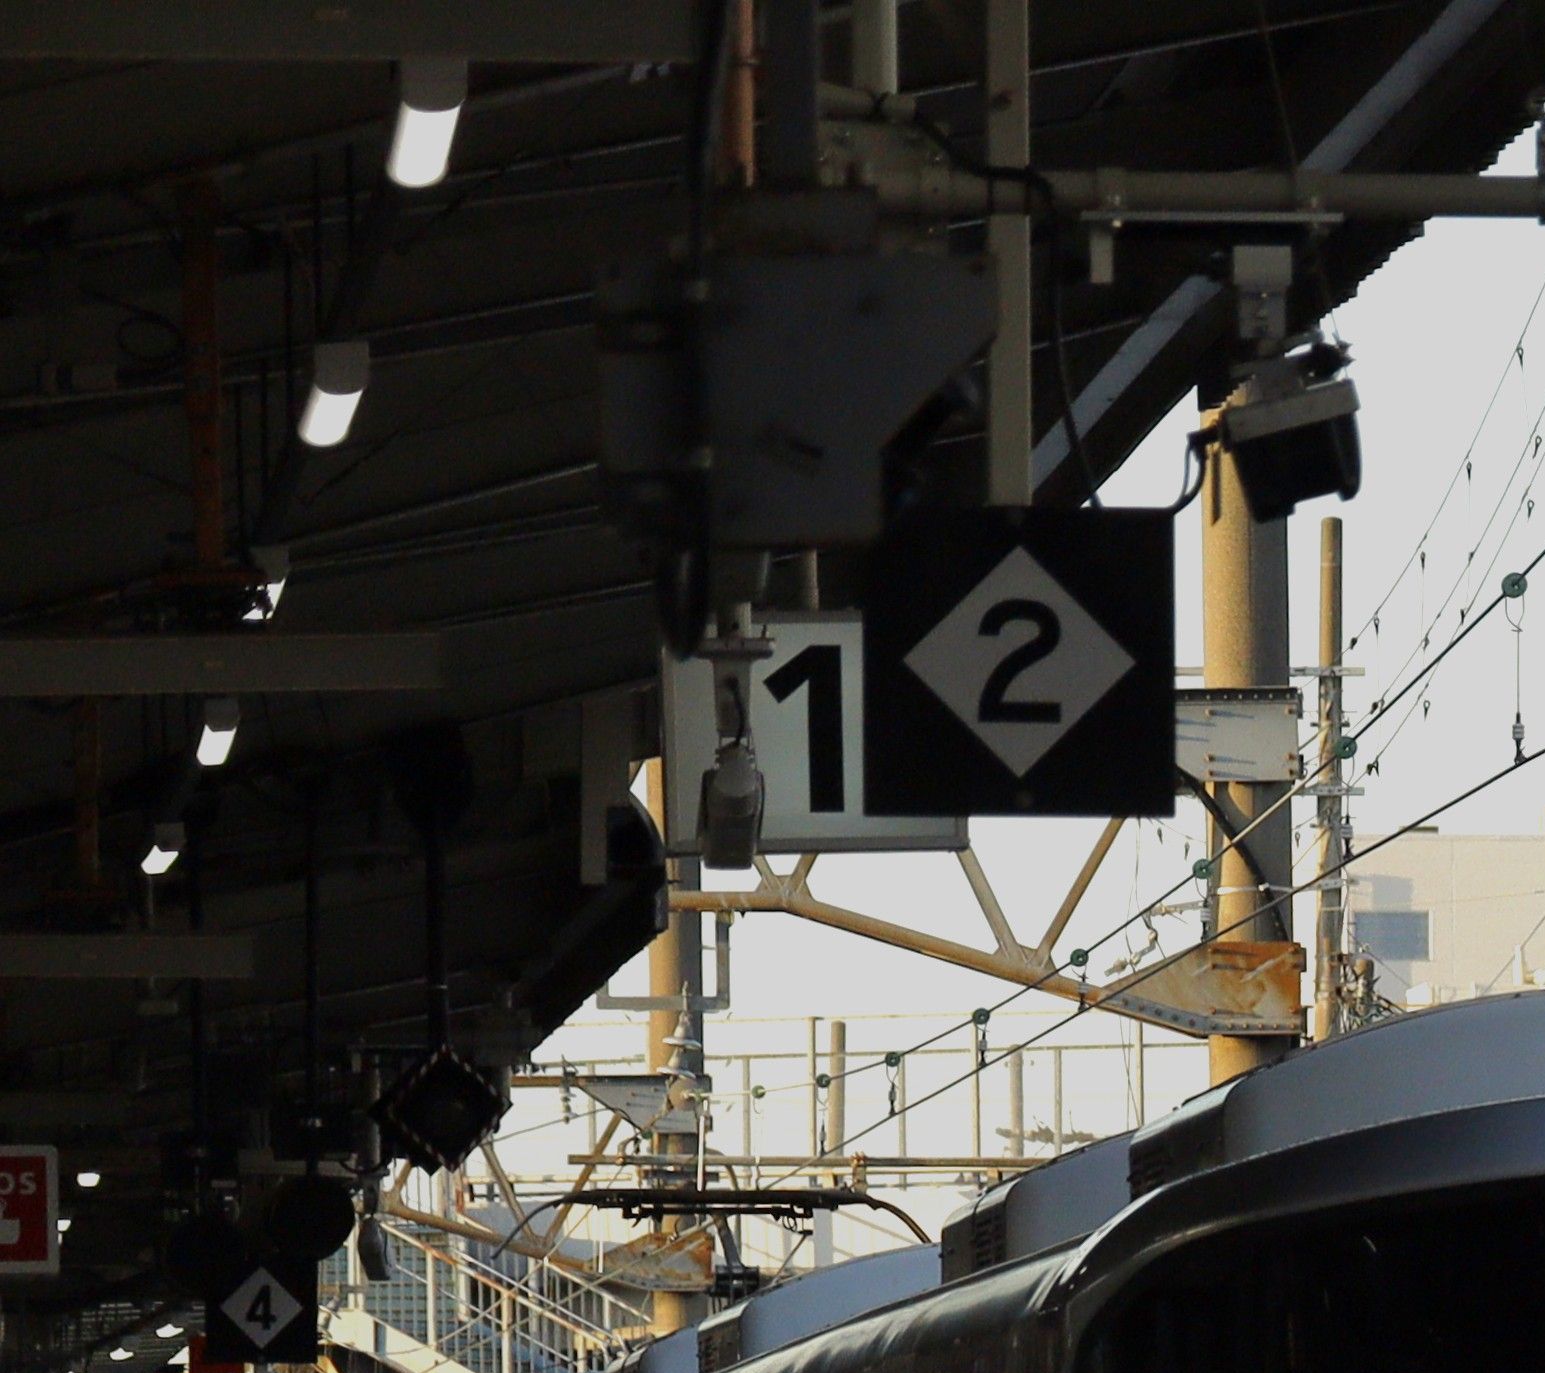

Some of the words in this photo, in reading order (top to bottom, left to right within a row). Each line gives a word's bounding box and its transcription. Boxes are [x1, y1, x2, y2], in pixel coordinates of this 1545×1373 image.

[976, 600, 1061, 723] 2
[763, 645, 844, 813] 1
[246, 1285, 277, 1331] 4
